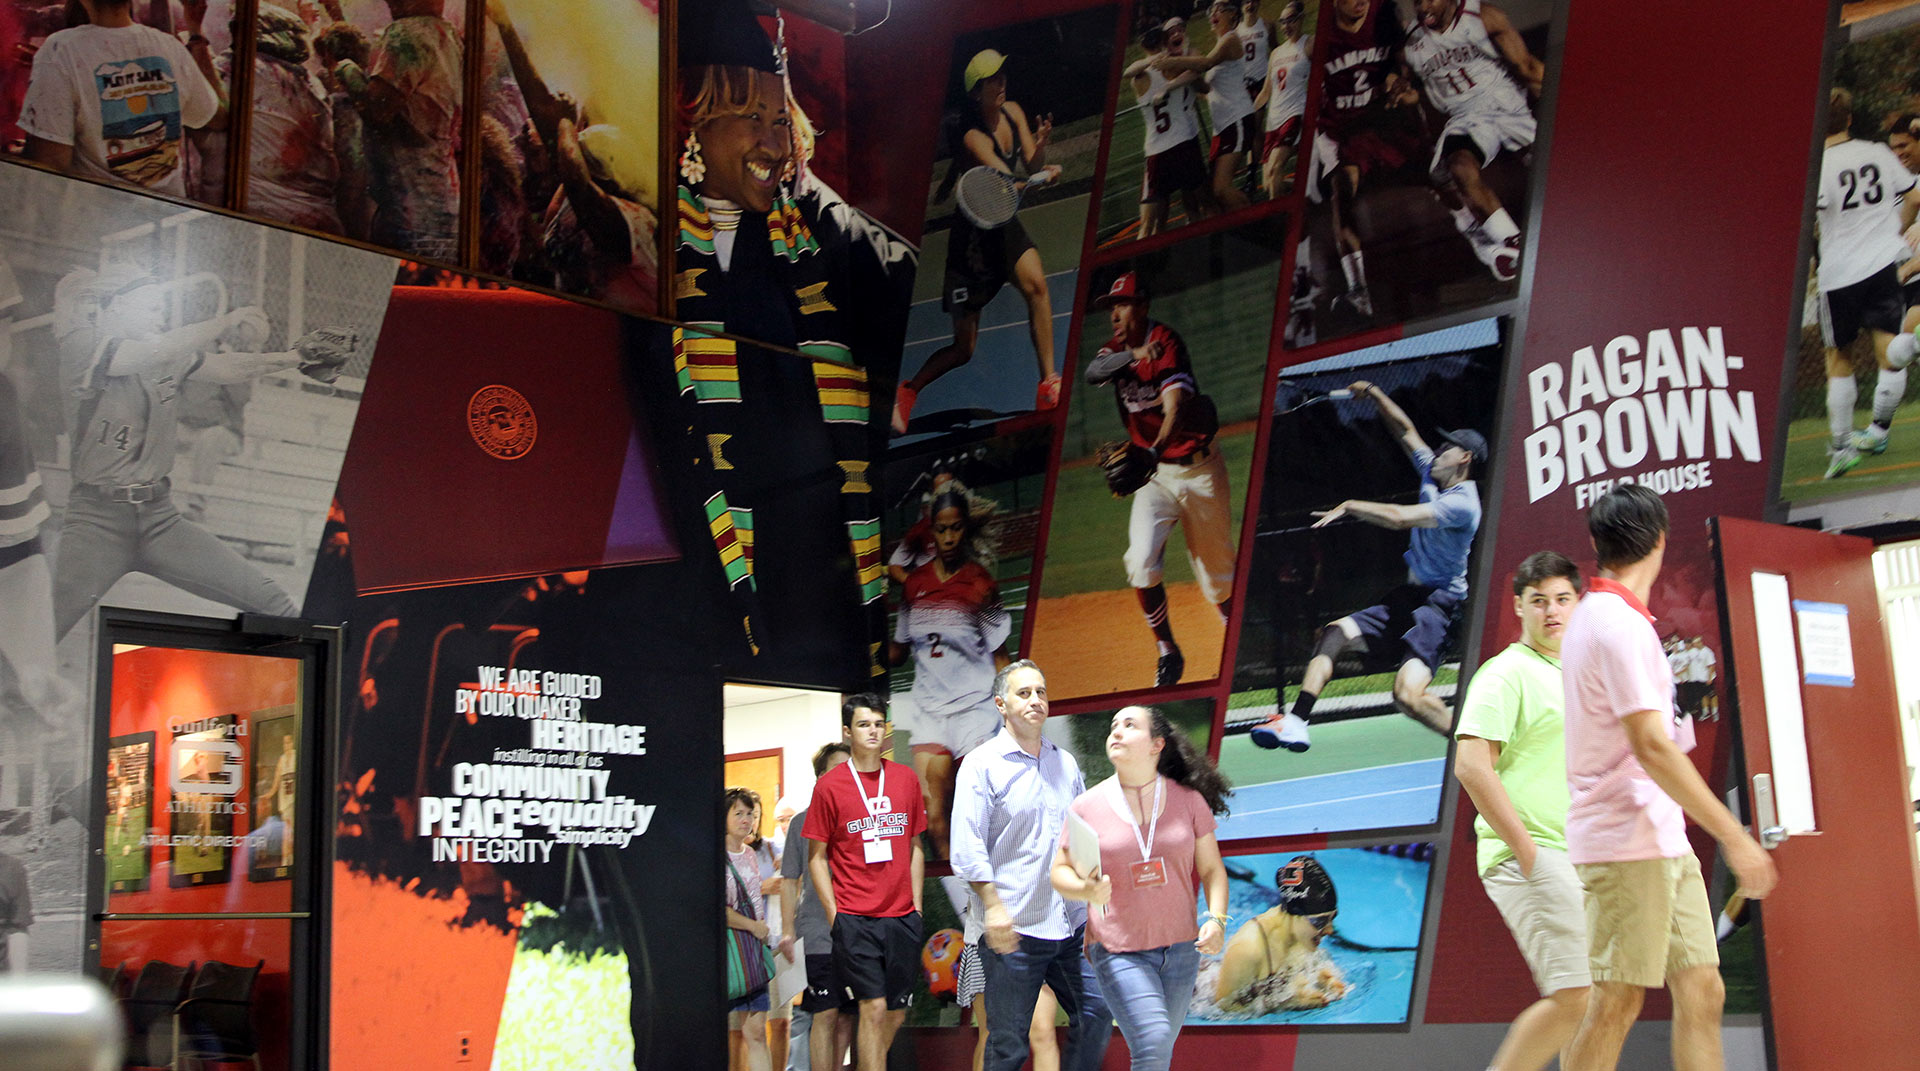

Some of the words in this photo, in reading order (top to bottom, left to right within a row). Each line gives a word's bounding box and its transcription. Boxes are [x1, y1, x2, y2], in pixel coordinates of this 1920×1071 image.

[1353, 70, 1370, 93] 2
[1153, 100, 1171, 133] 5
[1839, 163, 1884, 212] 23
[1527, 326, 1744, 431] RAGAN-
[97, 419, 131, 451] 14
[1523, 388, 1762, 504] BROWN
[1638, 460, 1713, 496] HOUSE
[927, 632, 943, 658] 2
[477, 665, 505, 692] WE
[507, 668, 541, 694] ARE
[541, 670, 602, 700] GUIDED
[455, 689, 479, 714] BY
[480, 691, 515, 717] OUR
[516, 693, 582, 722] QUAKER
[166, 715, 248, 736] Guilford
[531, 719, 646, 755] HERITAGE
[170, 738, 245, 797] G
[492, 747, 546, 767] instilling
[588, 756, 604, 767] us
[452, 761, 611, 801] COMMUNITY
[163, 801, 247, 815] ATHLETICS
[419, 796, 523, 839] PEACE
[521, 796, 657, 837] equality
[138, 834, 203, 847] ATHLETIC
[205, 835, 267, 848] DIRECTOR
[432, 837, 555, 864] INTEGRITY
[555, 828, 634, 849] simplicity
